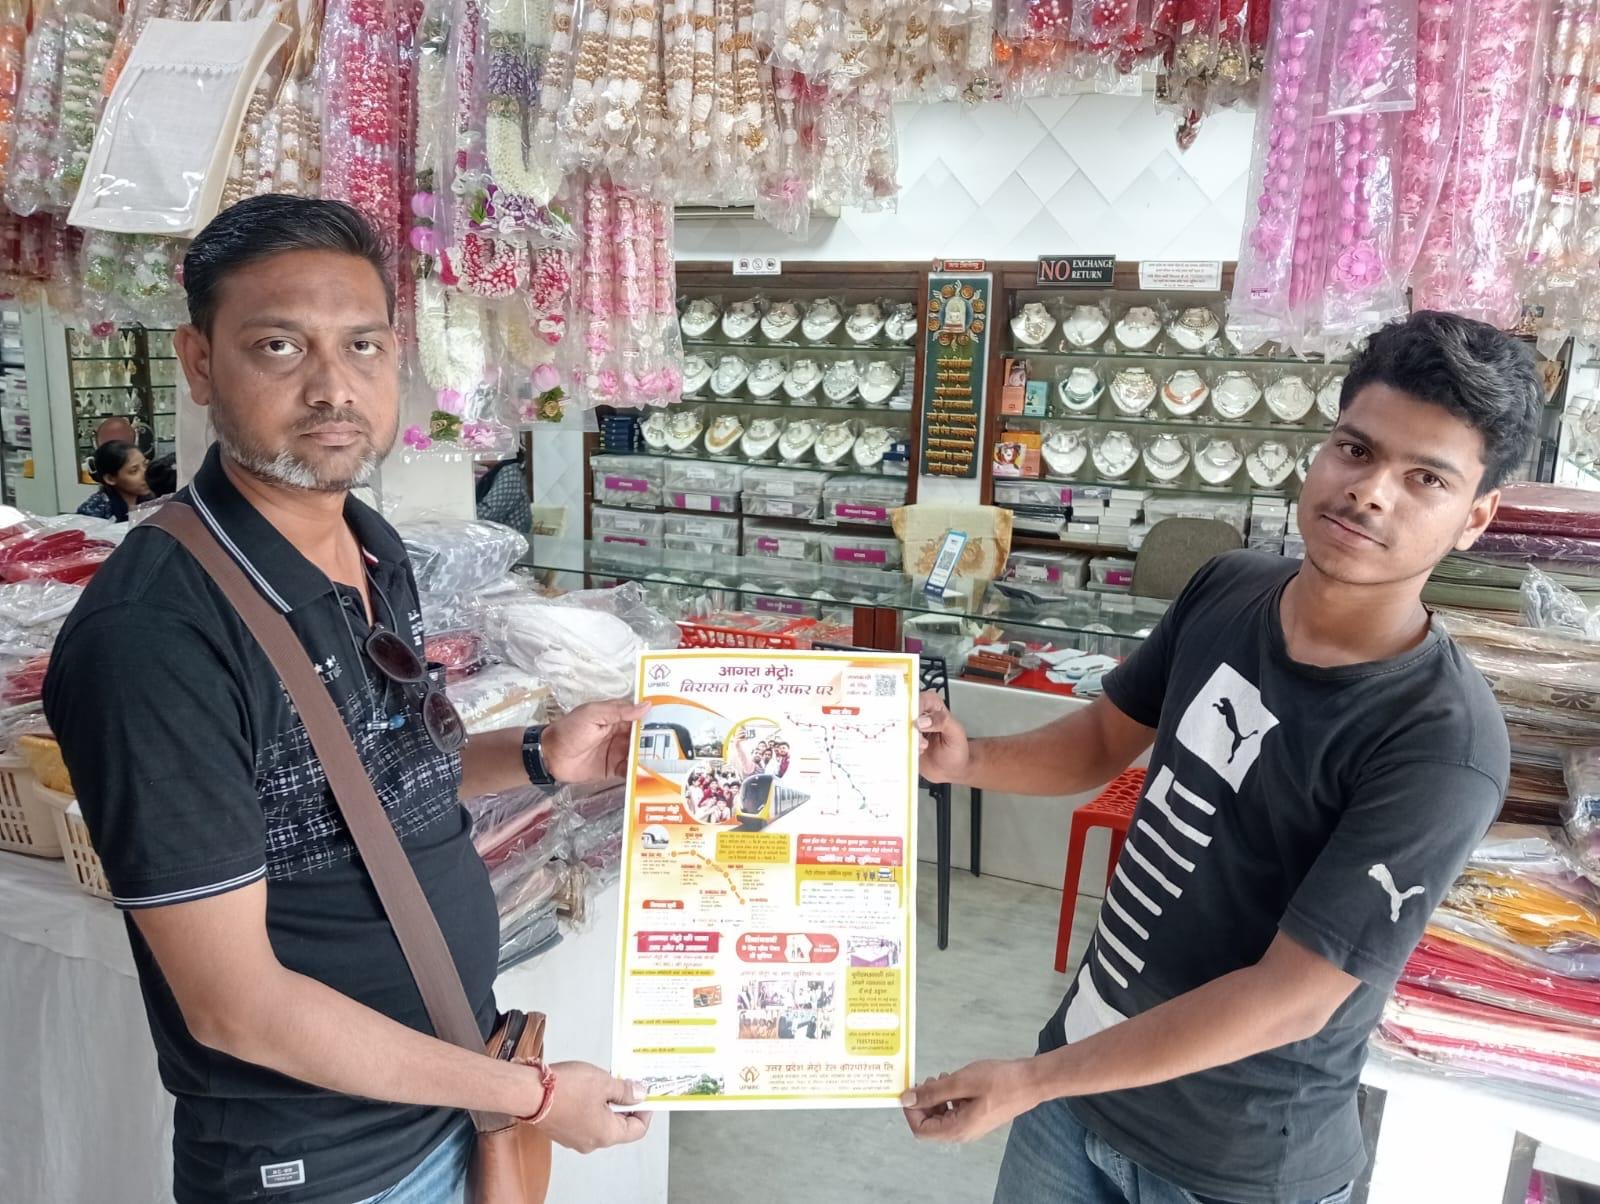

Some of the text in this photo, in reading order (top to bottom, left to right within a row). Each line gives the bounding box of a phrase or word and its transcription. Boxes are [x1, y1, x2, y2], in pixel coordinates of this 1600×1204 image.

[1040, 259, 1114, 281] NO EXCHANGE
[1071, 270, 1103, 279] RETURN
[718, 665, 760, 677] आगरा
[679, 678, 729, 693] विरासत
[733, 679, 749, 693] के
[752, 683, 773, 698] नए
[815, 684, 834, 696] पर
[765, 1064, 783, 1072] उत्तर
[785, 1063, 804, 1072] प्रदेश
[807, 1062, 822, 1072] मेट्रो
